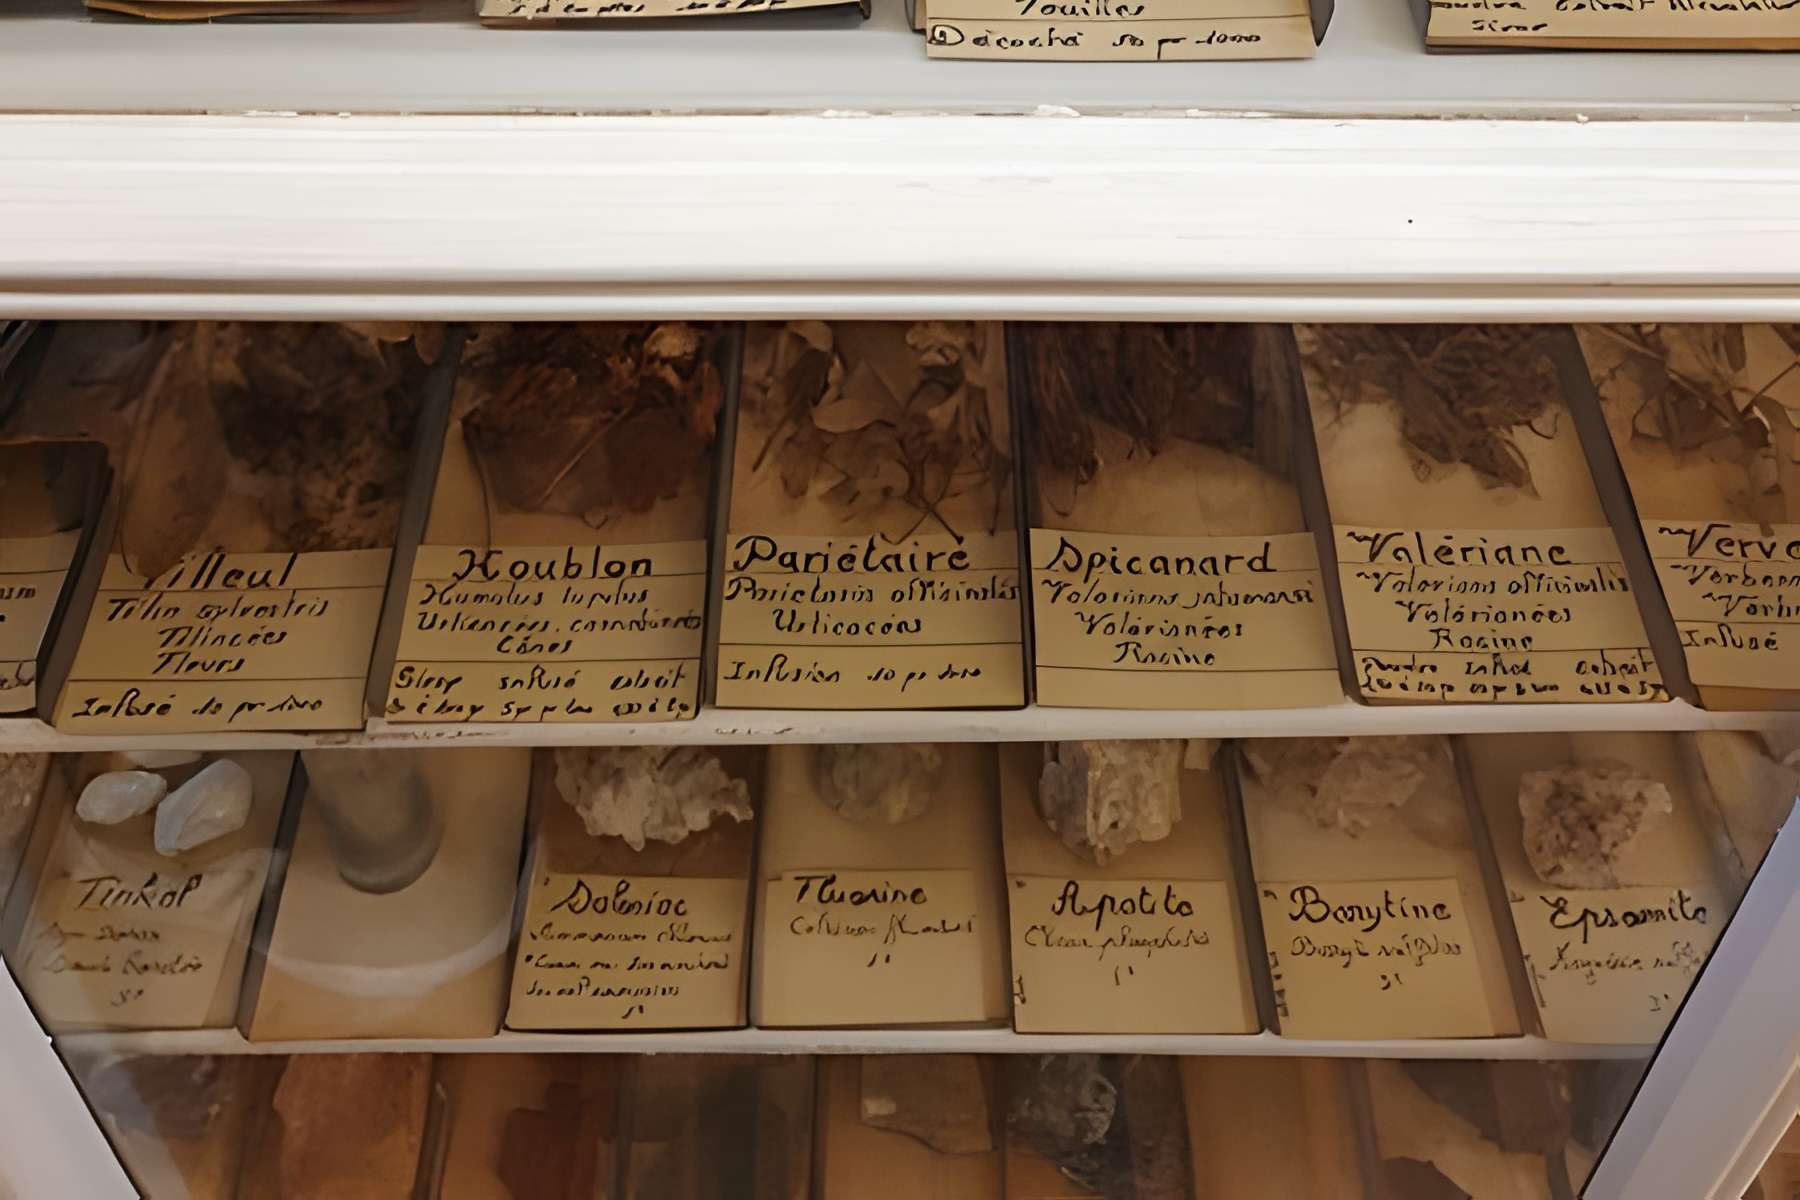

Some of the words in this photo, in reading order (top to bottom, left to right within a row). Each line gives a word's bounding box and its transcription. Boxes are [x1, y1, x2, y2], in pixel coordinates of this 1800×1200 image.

[452, 545, 652, 581] Houblon
[733, 535, 969, 573] Pariétaire
[1045, 536, 1277, 582] Spicanard
[1346, 532, 1571, 565] Valériane
